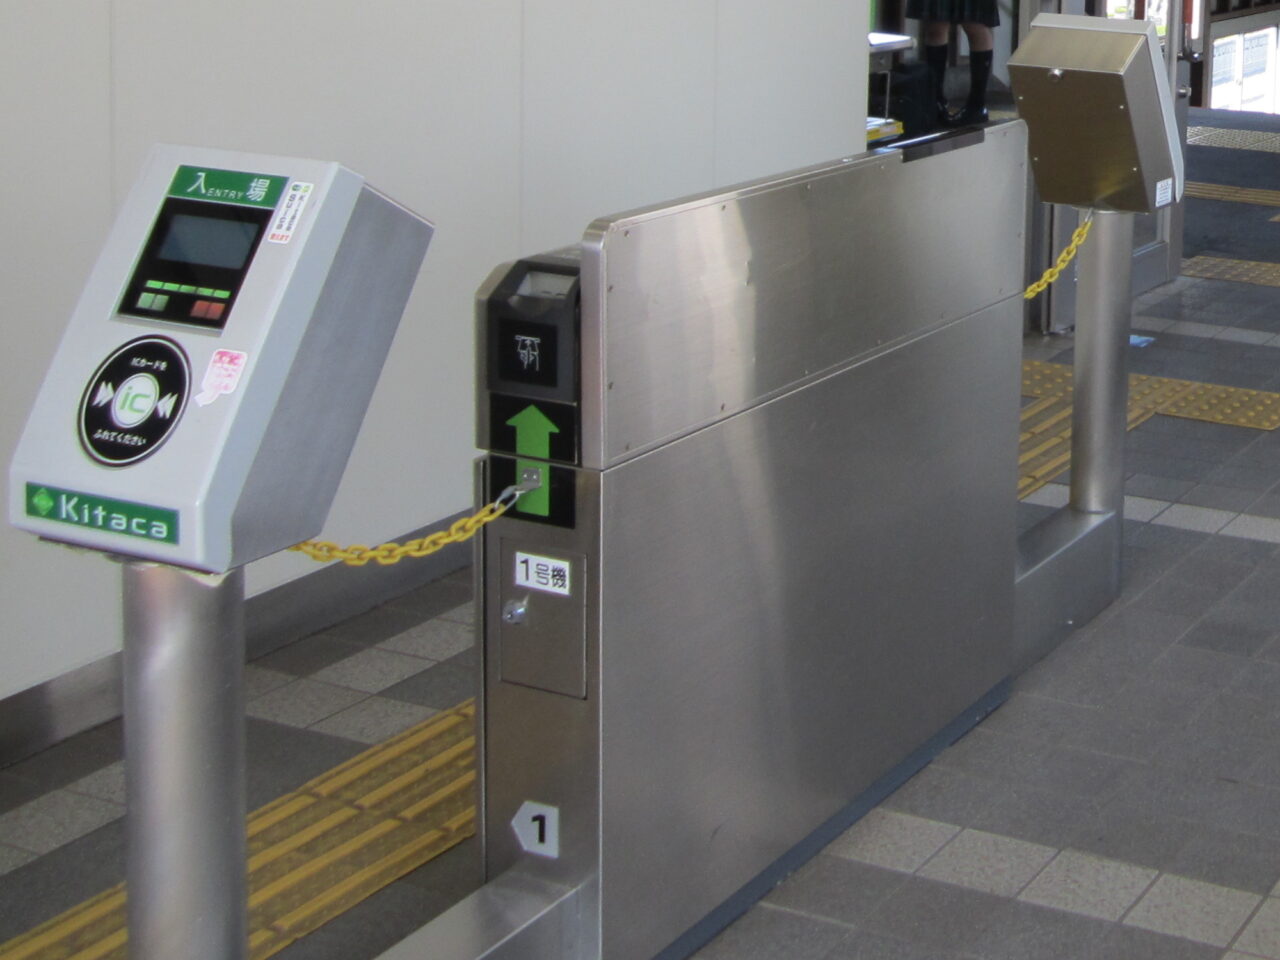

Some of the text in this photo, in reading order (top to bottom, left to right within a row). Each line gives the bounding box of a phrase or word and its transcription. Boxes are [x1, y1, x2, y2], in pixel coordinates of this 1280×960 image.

[207, 187, 245, 200] ENTRY
[58, 494, 169, 538] Kitaca
[519, 556, 567, 588] 1号機
[529, 814, 547, 844] 1
